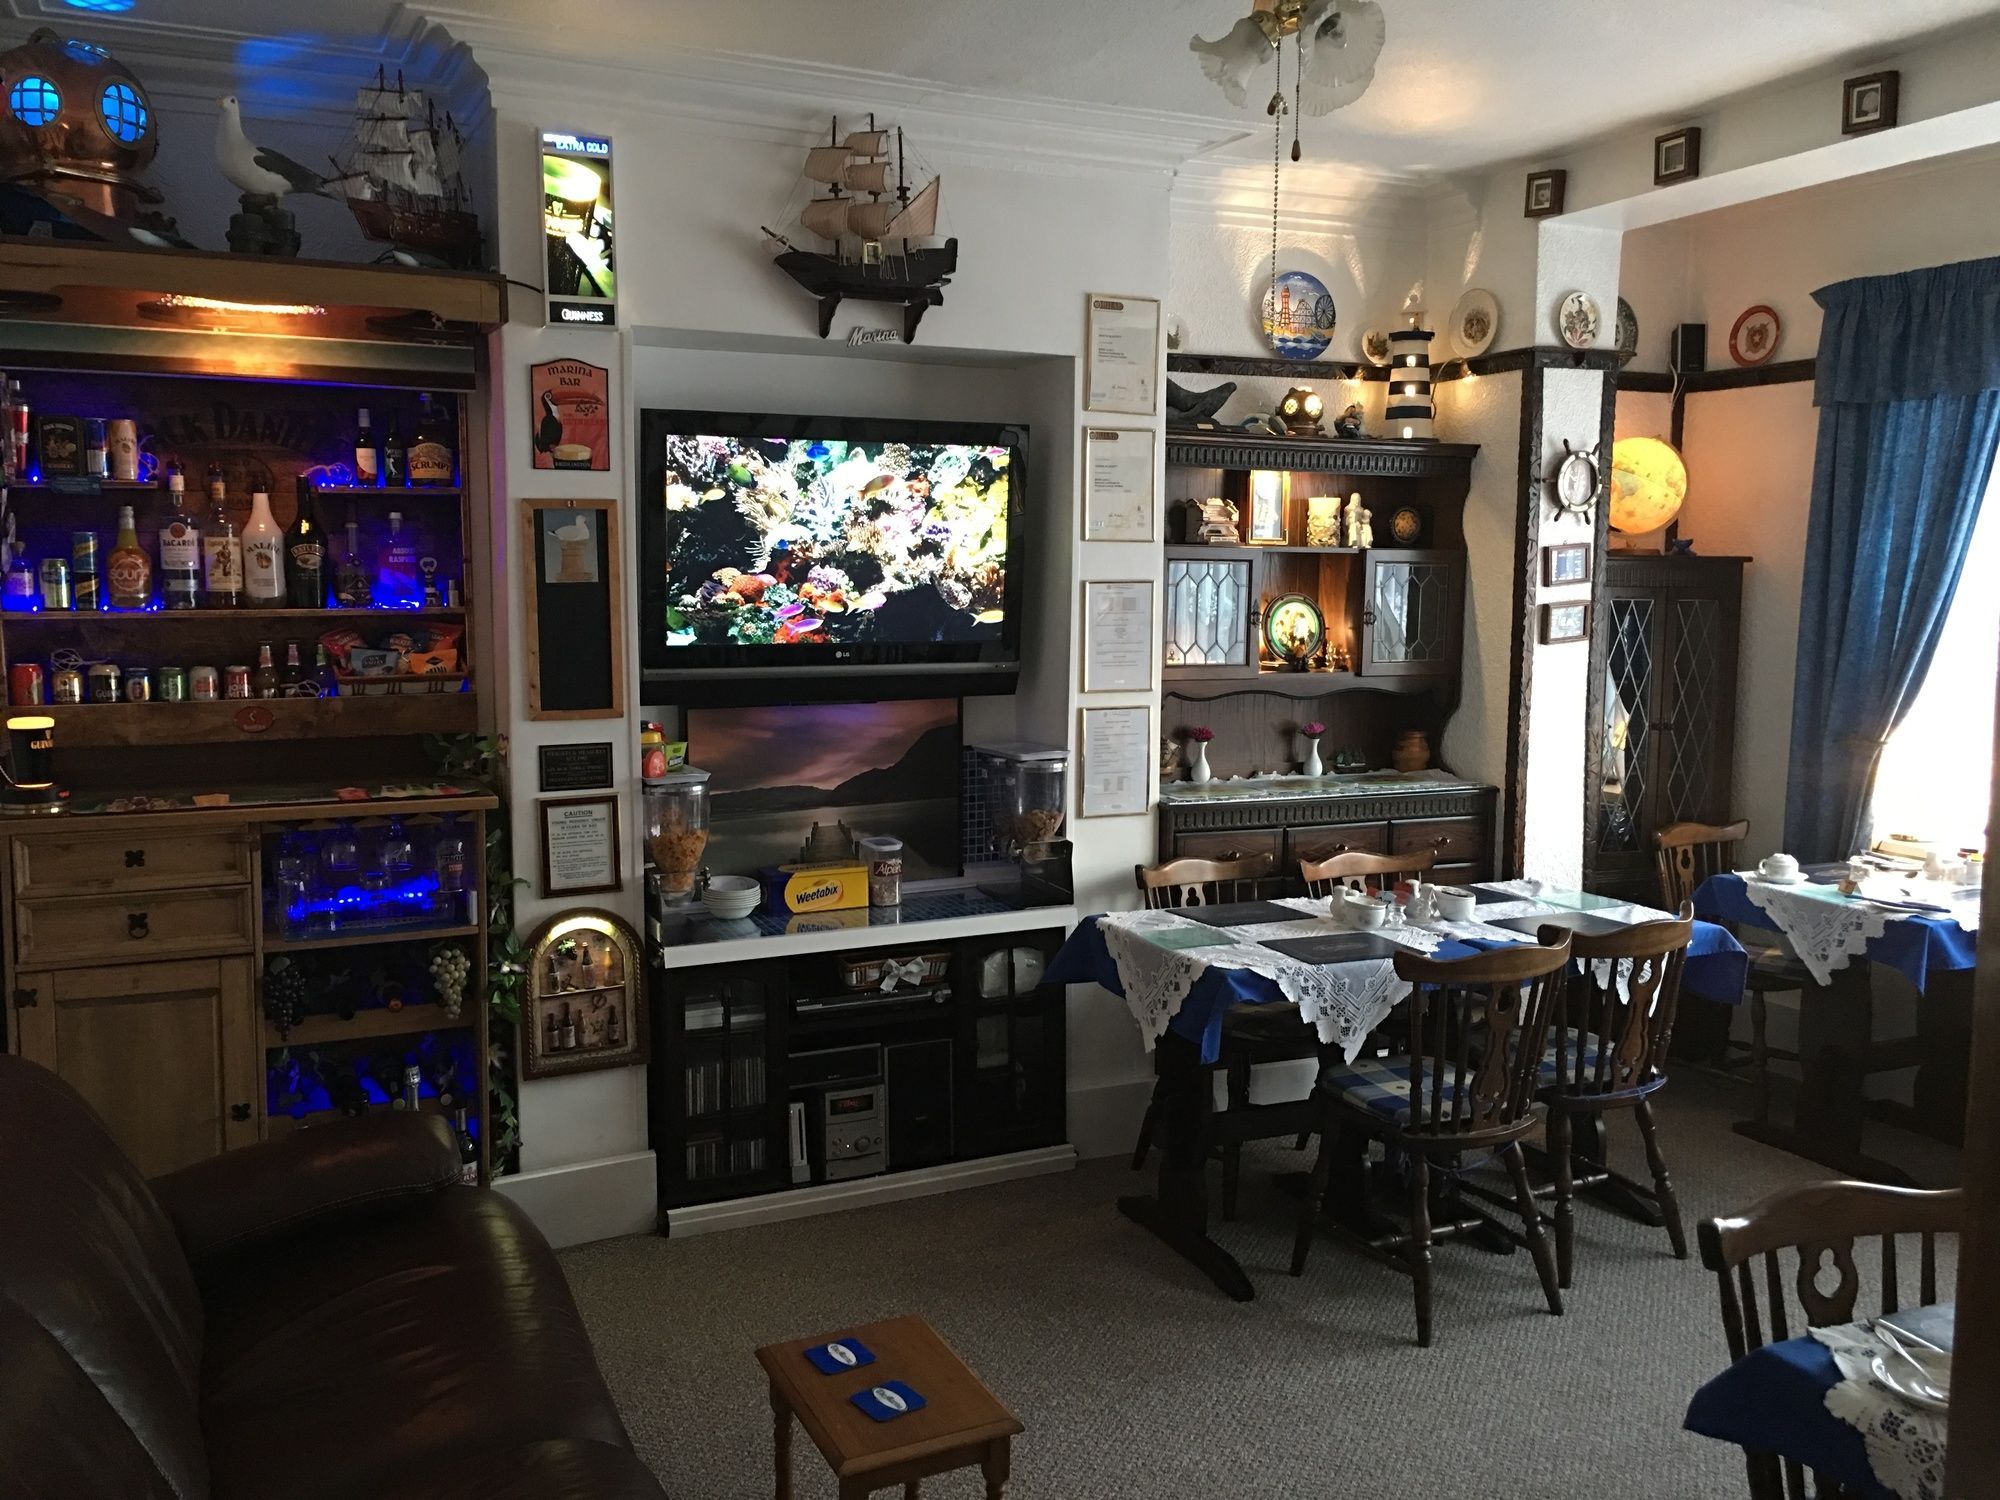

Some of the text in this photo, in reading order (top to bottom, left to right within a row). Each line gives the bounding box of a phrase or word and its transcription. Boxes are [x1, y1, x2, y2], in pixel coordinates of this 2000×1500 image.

[561, 308, 604, 322] GUINNESS
[847, 326, 899, 347] Marina
[547, 365, 593, 378] MARINA
[560, 378, 581, 387] BAR
[564, 810, 593, 818] CAUTION
[875, 863, 902, 876] Alpen
[795, 885, 838, 904] Weetabix
